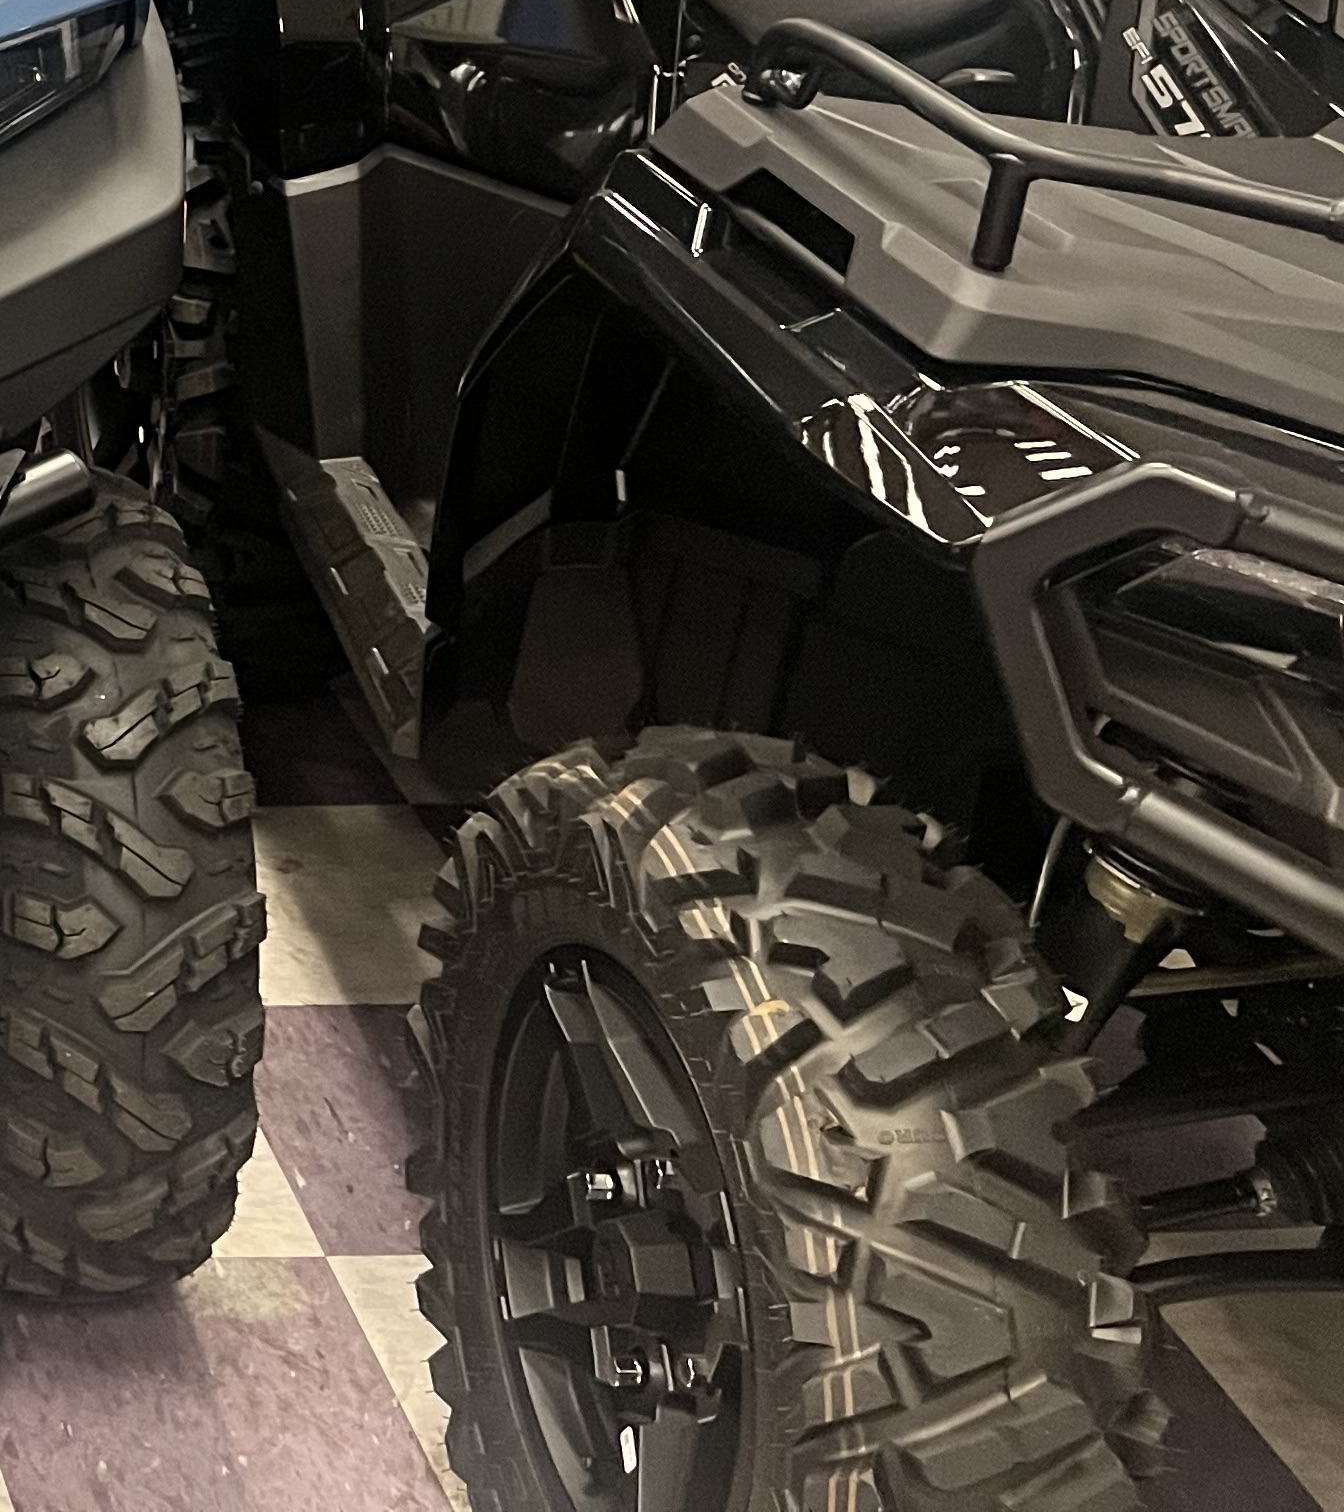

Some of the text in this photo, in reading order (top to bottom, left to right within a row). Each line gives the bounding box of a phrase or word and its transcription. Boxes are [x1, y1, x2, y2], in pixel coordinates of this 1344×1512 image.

[1122, 27, 1153, 65] EFI
[1153, 11, 1257, 138] SPORTSMA
[1141, 64, 1212, 138] 57
